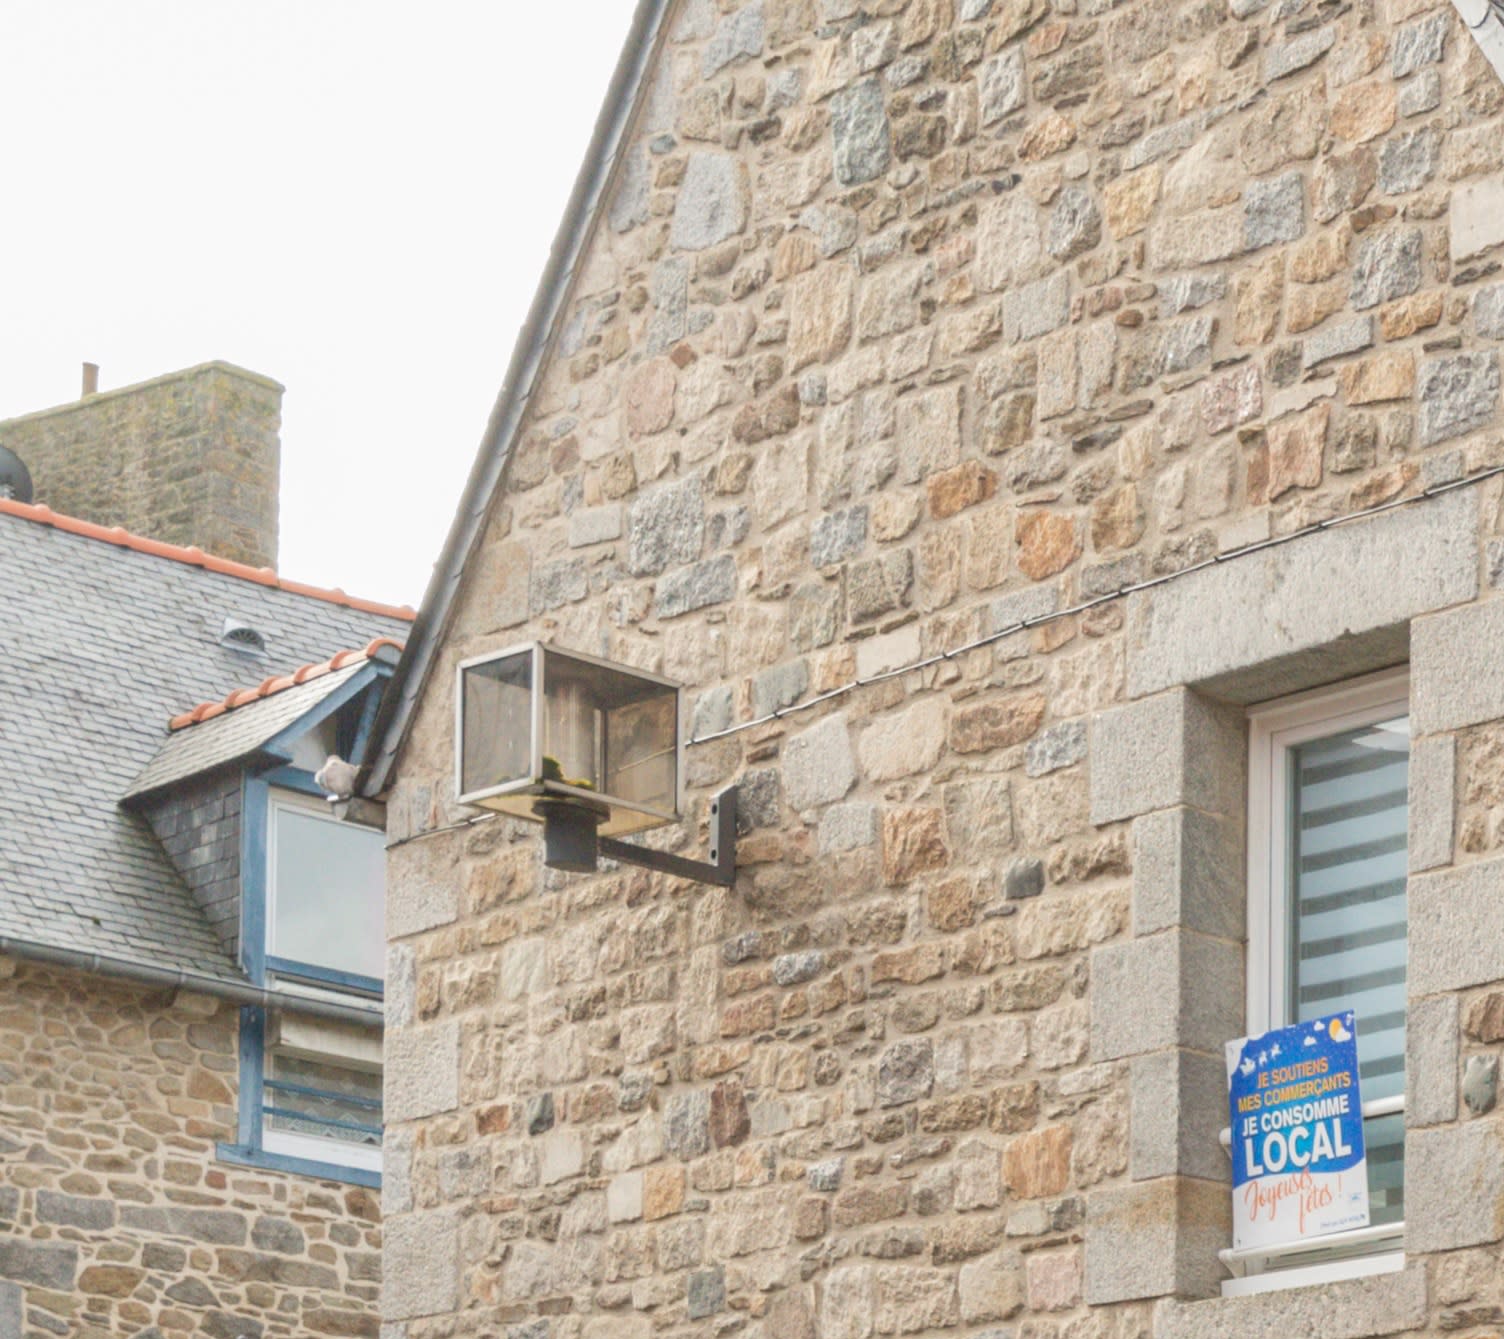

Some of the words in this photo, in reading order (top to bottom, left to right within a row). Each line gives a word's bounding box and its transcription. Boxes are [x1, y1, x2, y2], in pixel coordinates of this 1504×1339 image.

[1238, 1097, 1261, 1112] MES
[1264, 1072, 1351, 1106] COMMERÇANTS
[1257, 1070, 1270, 1088] JE
[1271, 1057, 1328, 1085] SOUTIENS
[1242, 1116, 1258, 1136] JE
[1261, 1095, 1349, 1132] CONSOMME
[1244, 1119, 1351, 1176] LOCAL
[1244, 1166, 1312, 1221] Joyeuses
